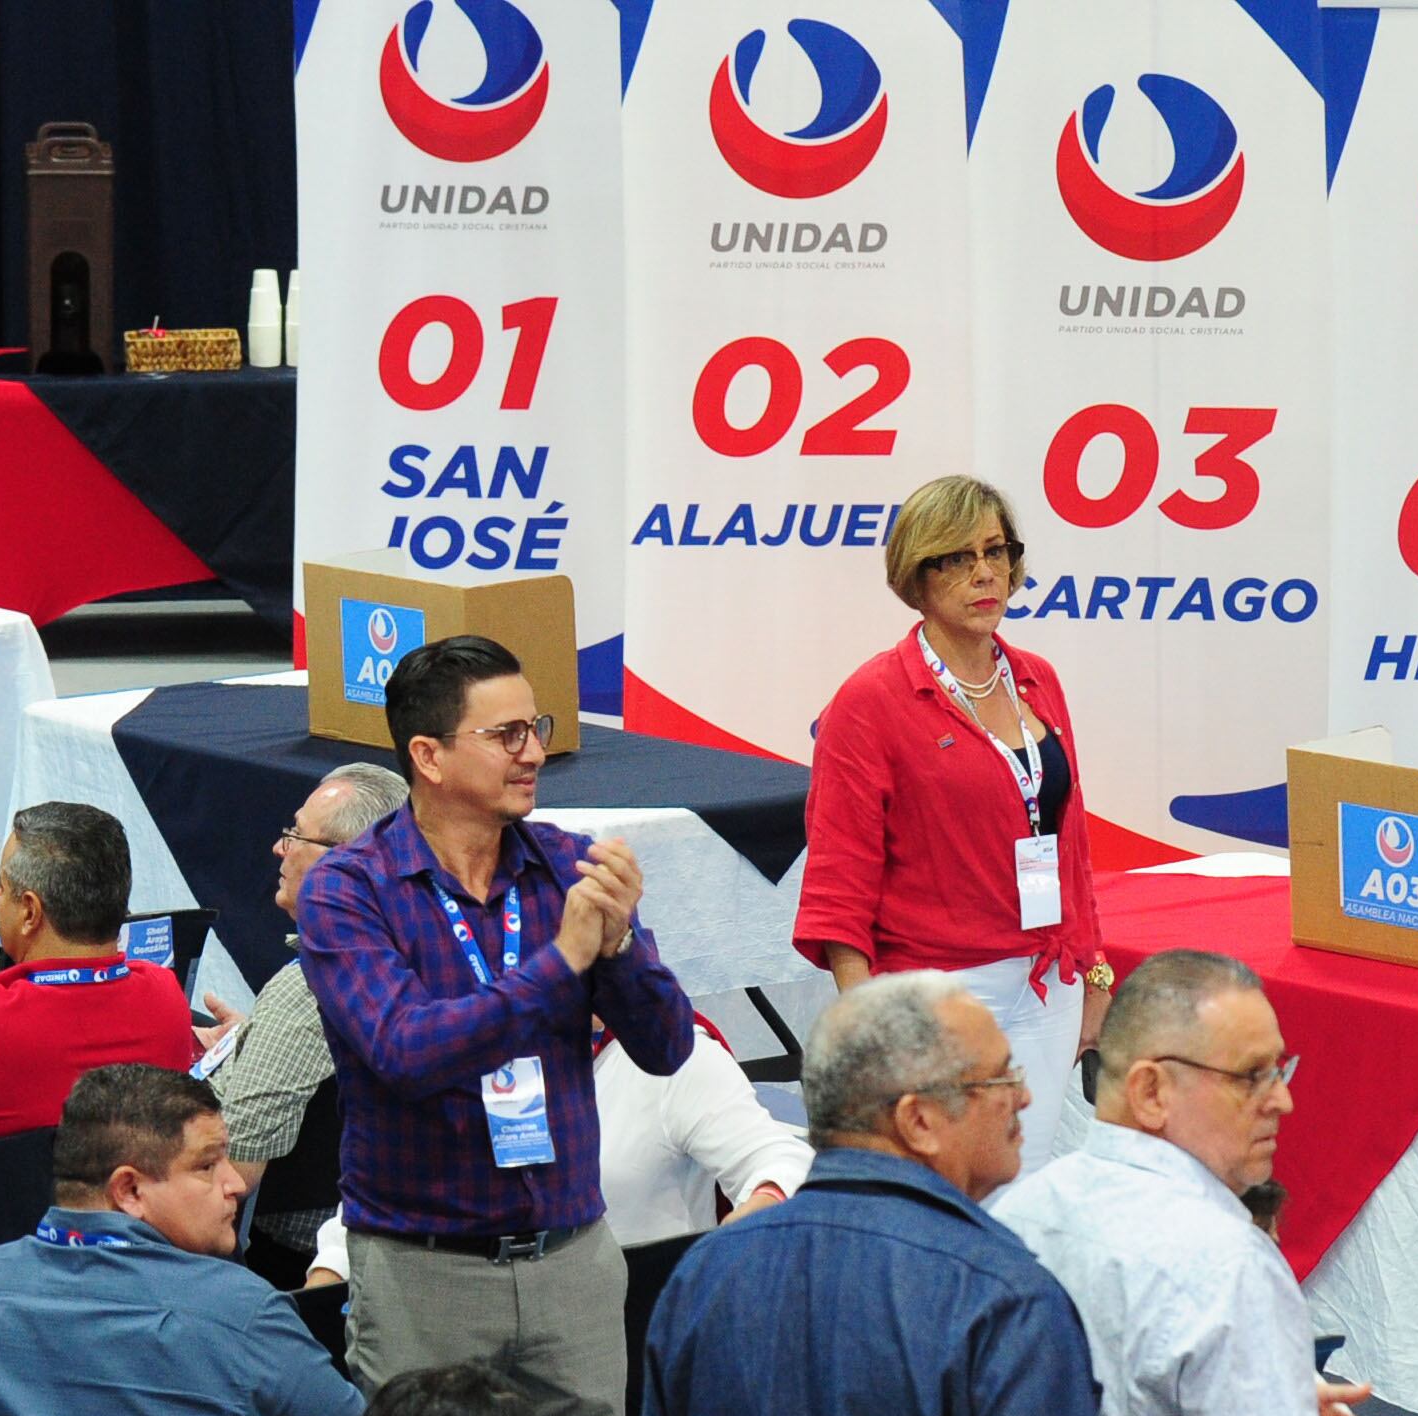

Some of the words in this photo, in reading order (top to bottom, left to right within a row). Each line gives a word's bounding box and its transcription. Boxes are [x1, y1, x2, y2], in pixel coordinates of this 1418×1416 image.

[380, 184, 549, 215] UNIDAD
[379, 222, 420, 230] PARTIDO
[421, 222, 459, 230] UNIDAD
[461, 222, 496, 230] SOCIAL
[498, 222, 548, 231] CRISTIANA
[711, 222, 888, 253] UNIDAD
[709, 261, 752, 269] PARTIDO
[754, 261, 793, 269] UNIDAD
[795, 261, 831, 269] SOCIAL
[834, 261, 886, 269] CRISTIANA
[1059, 285, 1246, 319] UNIDAD
[1058, 325, 1103, 334] PARTIDO
[1105, 326, 1147, 335] UNIDAD
[1149, 326, 1187, 335] SOCIAL
[1189, 327, 1245, 336] CRISTIANA
[378, 294, 559, 411] 01
[692, 336, 911, 458] 02
[380, 444, 549, 499] SAN
[1043, 403, 1278, 530] 03
[633, 503, 899, 546] ALAJUE
[1005, 575, 1319, 623] CARTAGO
[357, 657, 396, 686] A0
[1344, 902, 1396, 922] ASAMBLEA
[132, 942, 170, 955] González
[33, 974, 67, 985] UNIDAD
